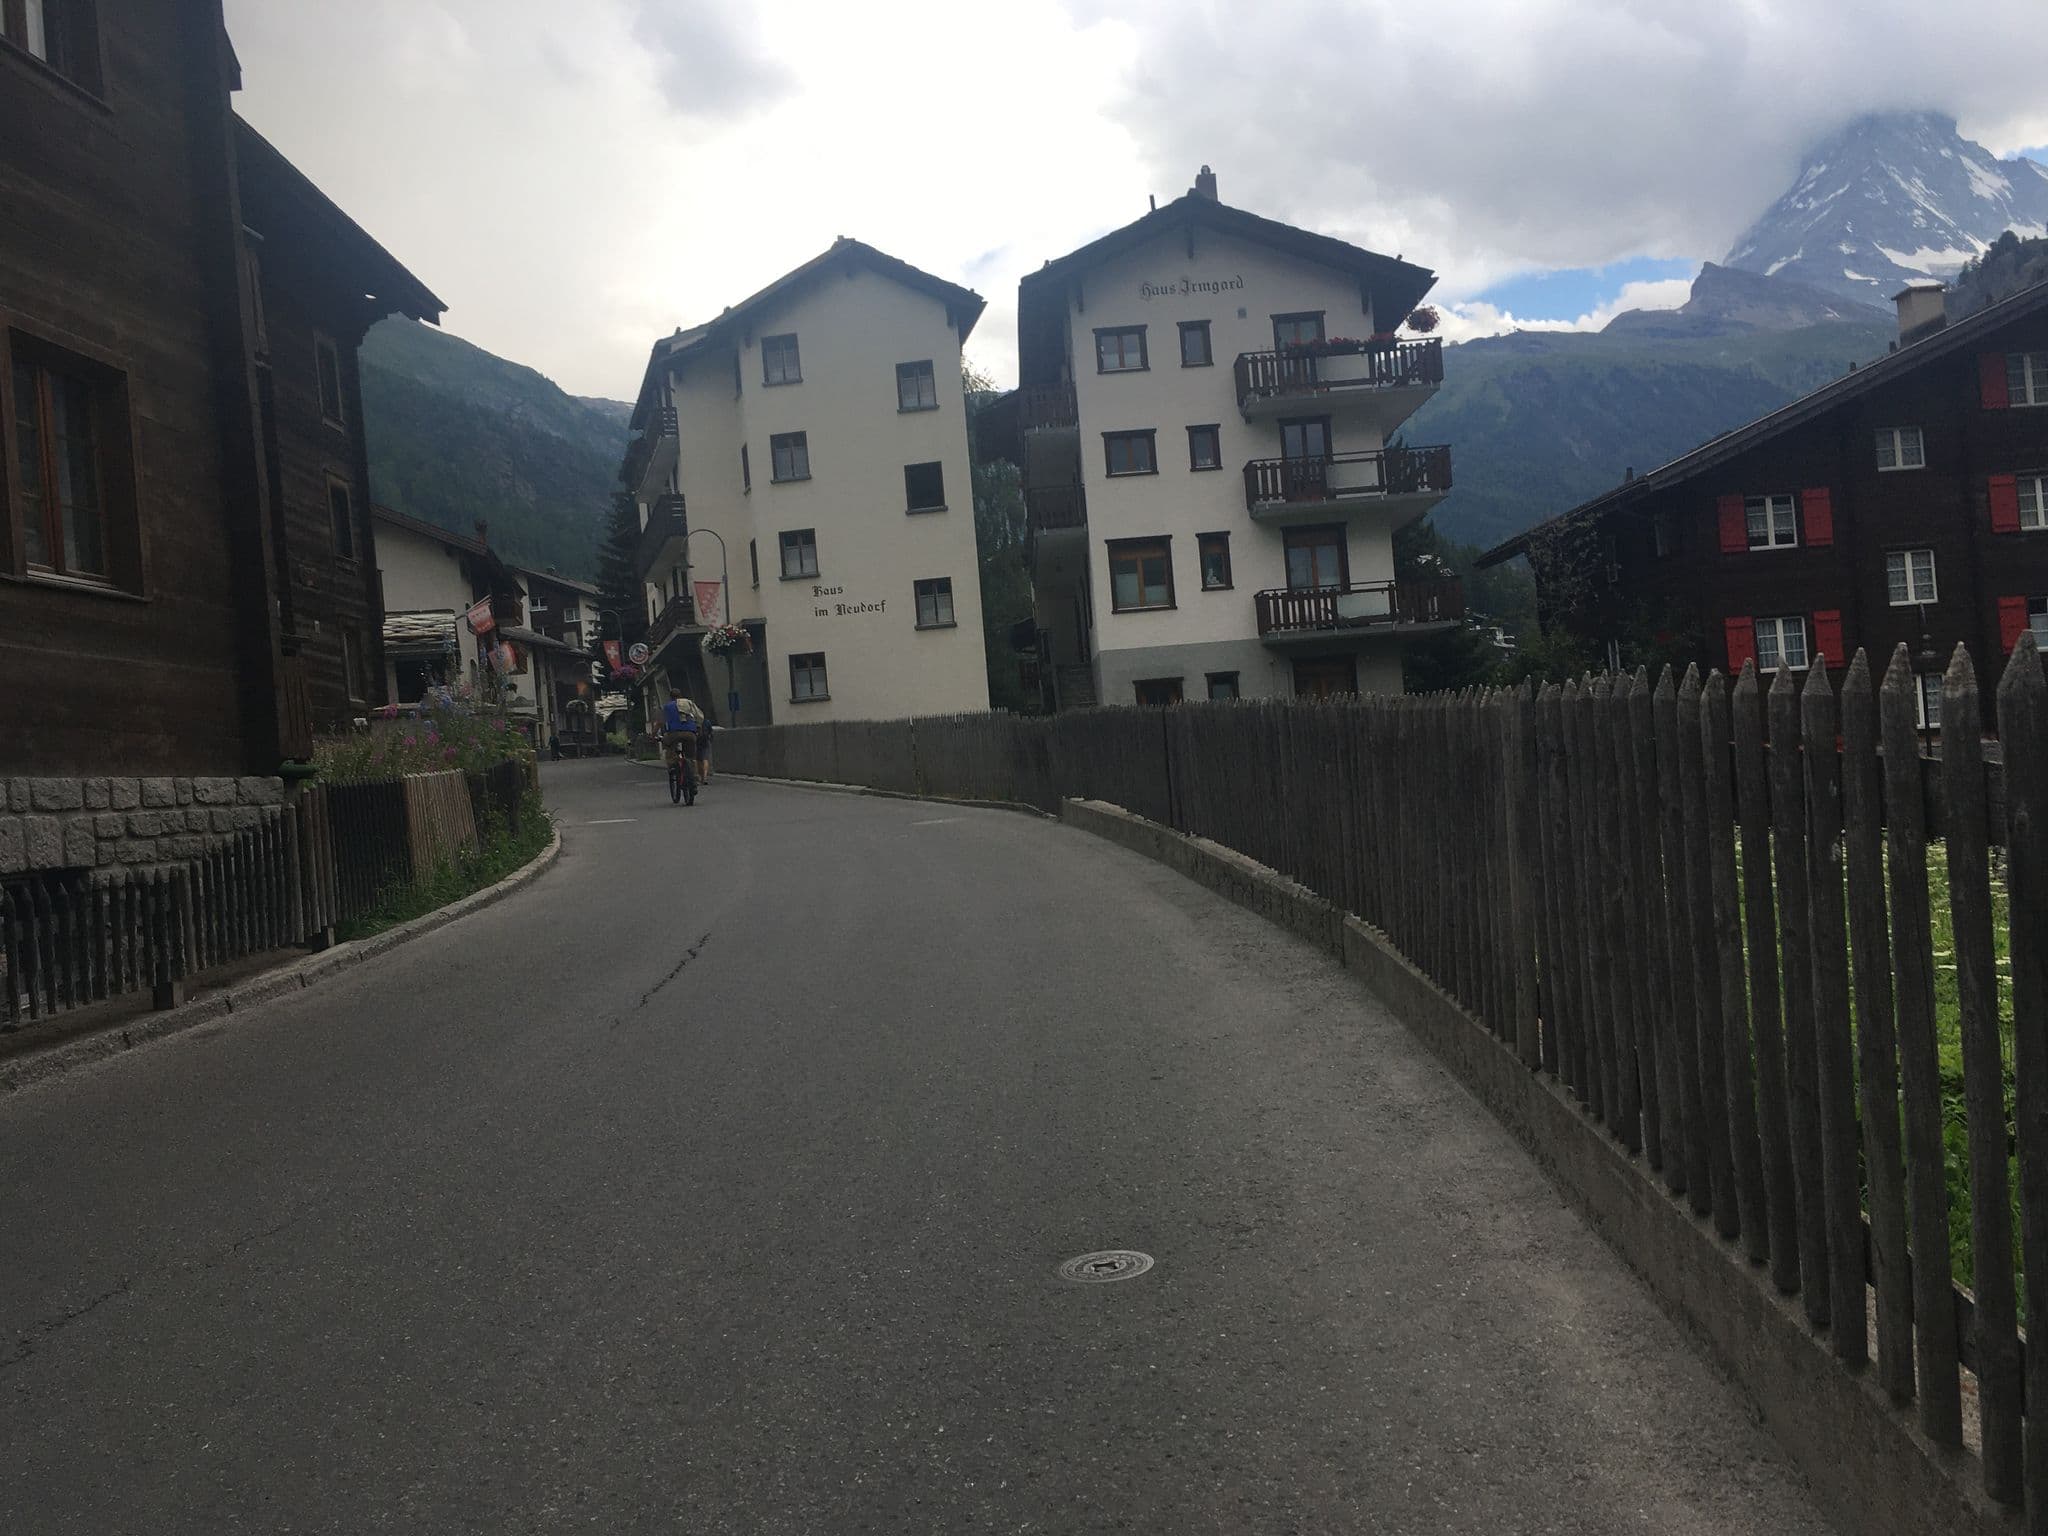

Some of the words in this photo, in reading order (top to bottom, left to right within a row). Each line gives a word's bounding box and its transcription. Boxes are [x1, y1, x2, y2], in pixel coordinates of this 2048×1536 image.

[1142, 281, 1177, 298] Haus
[812, 585, 844, 597] Haus
[814, 606, 829, 617] im
[835, 599, 886, 616] Neudorf
